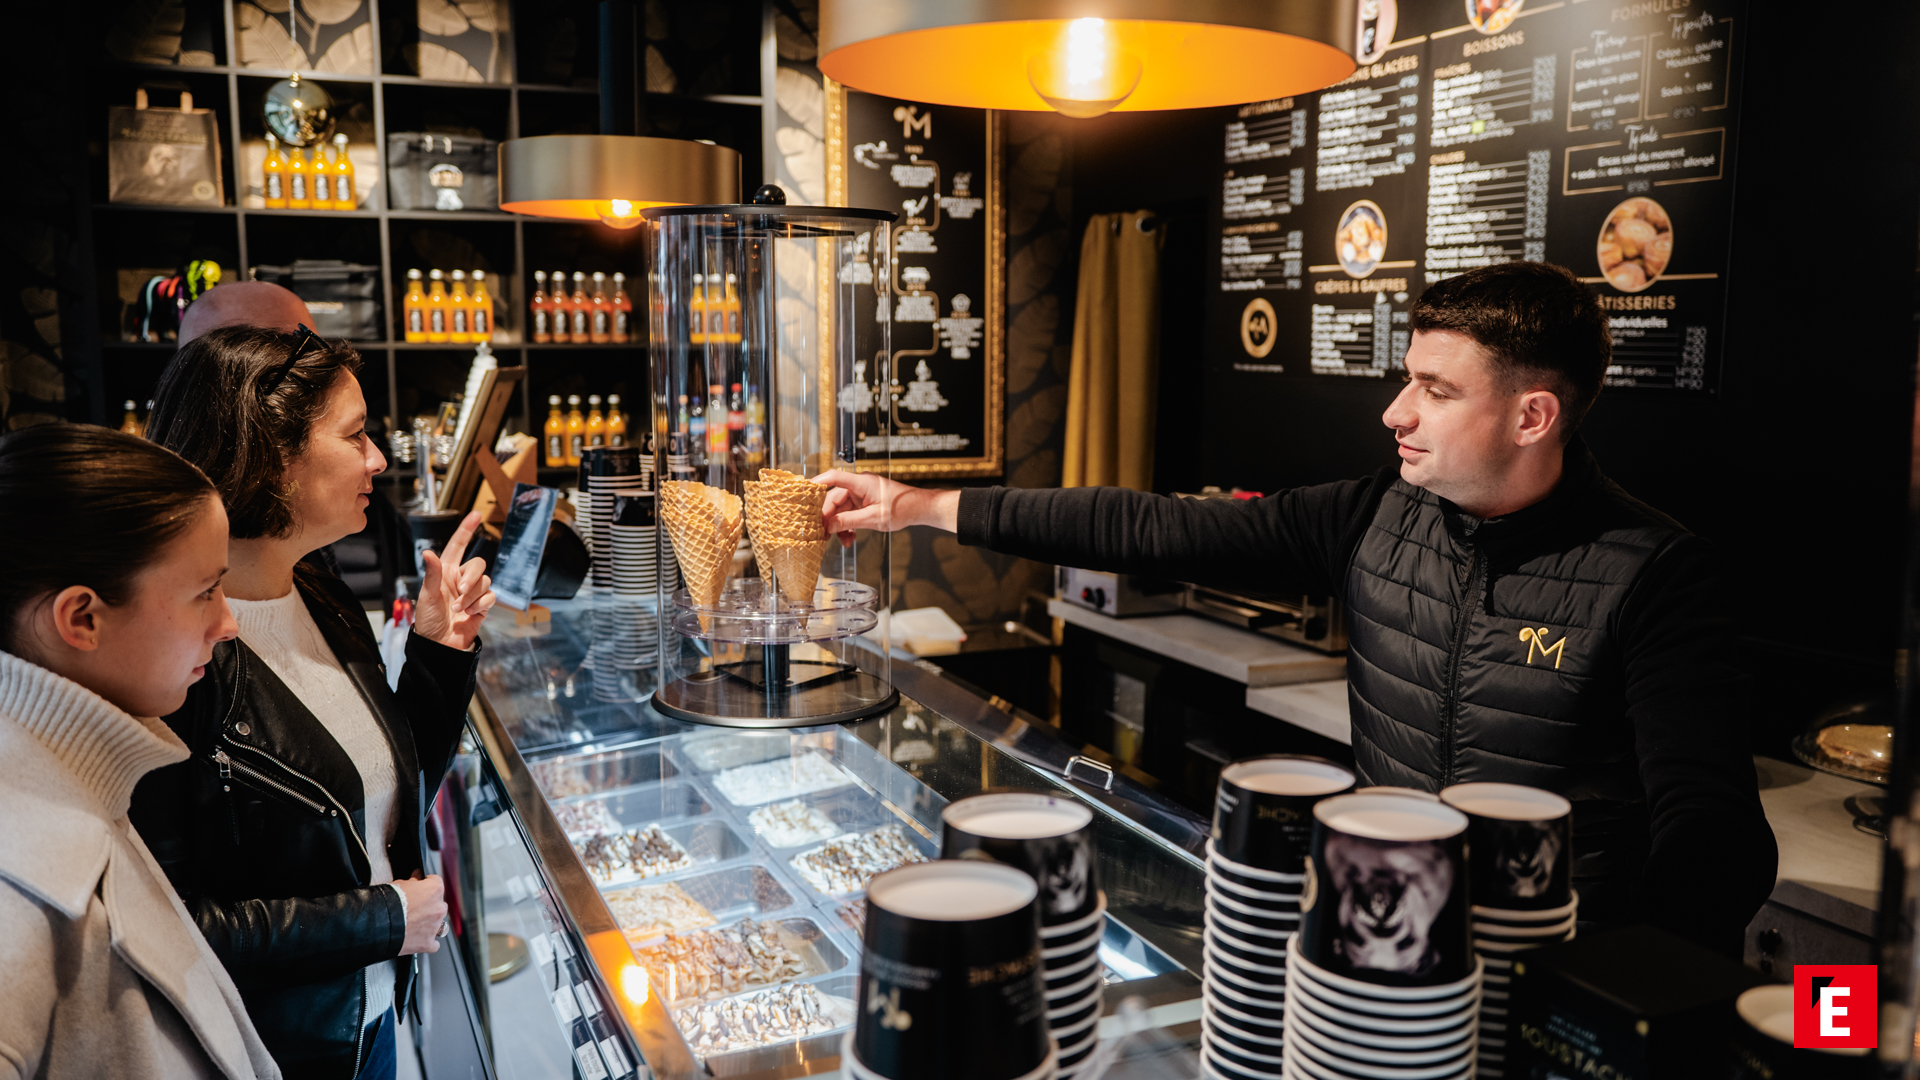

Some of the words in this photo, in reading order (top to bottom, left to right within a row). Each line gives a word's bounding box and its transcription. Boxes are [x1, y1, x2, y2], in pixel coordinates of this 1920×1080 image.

[1611, 0, 1691, 22] FORMULES
[1463, 30, 1525, 57] BOISSONS
[1370, 54, 1418, 79] GLACÉES
[1650, 147, 1686, 160] moment
[1315, 278, 1351, 295] CRÊPES
[1360, 278, 1408, 294] GAUFRES
[1597, 294, 1676, 310] ÂTISSERIES
